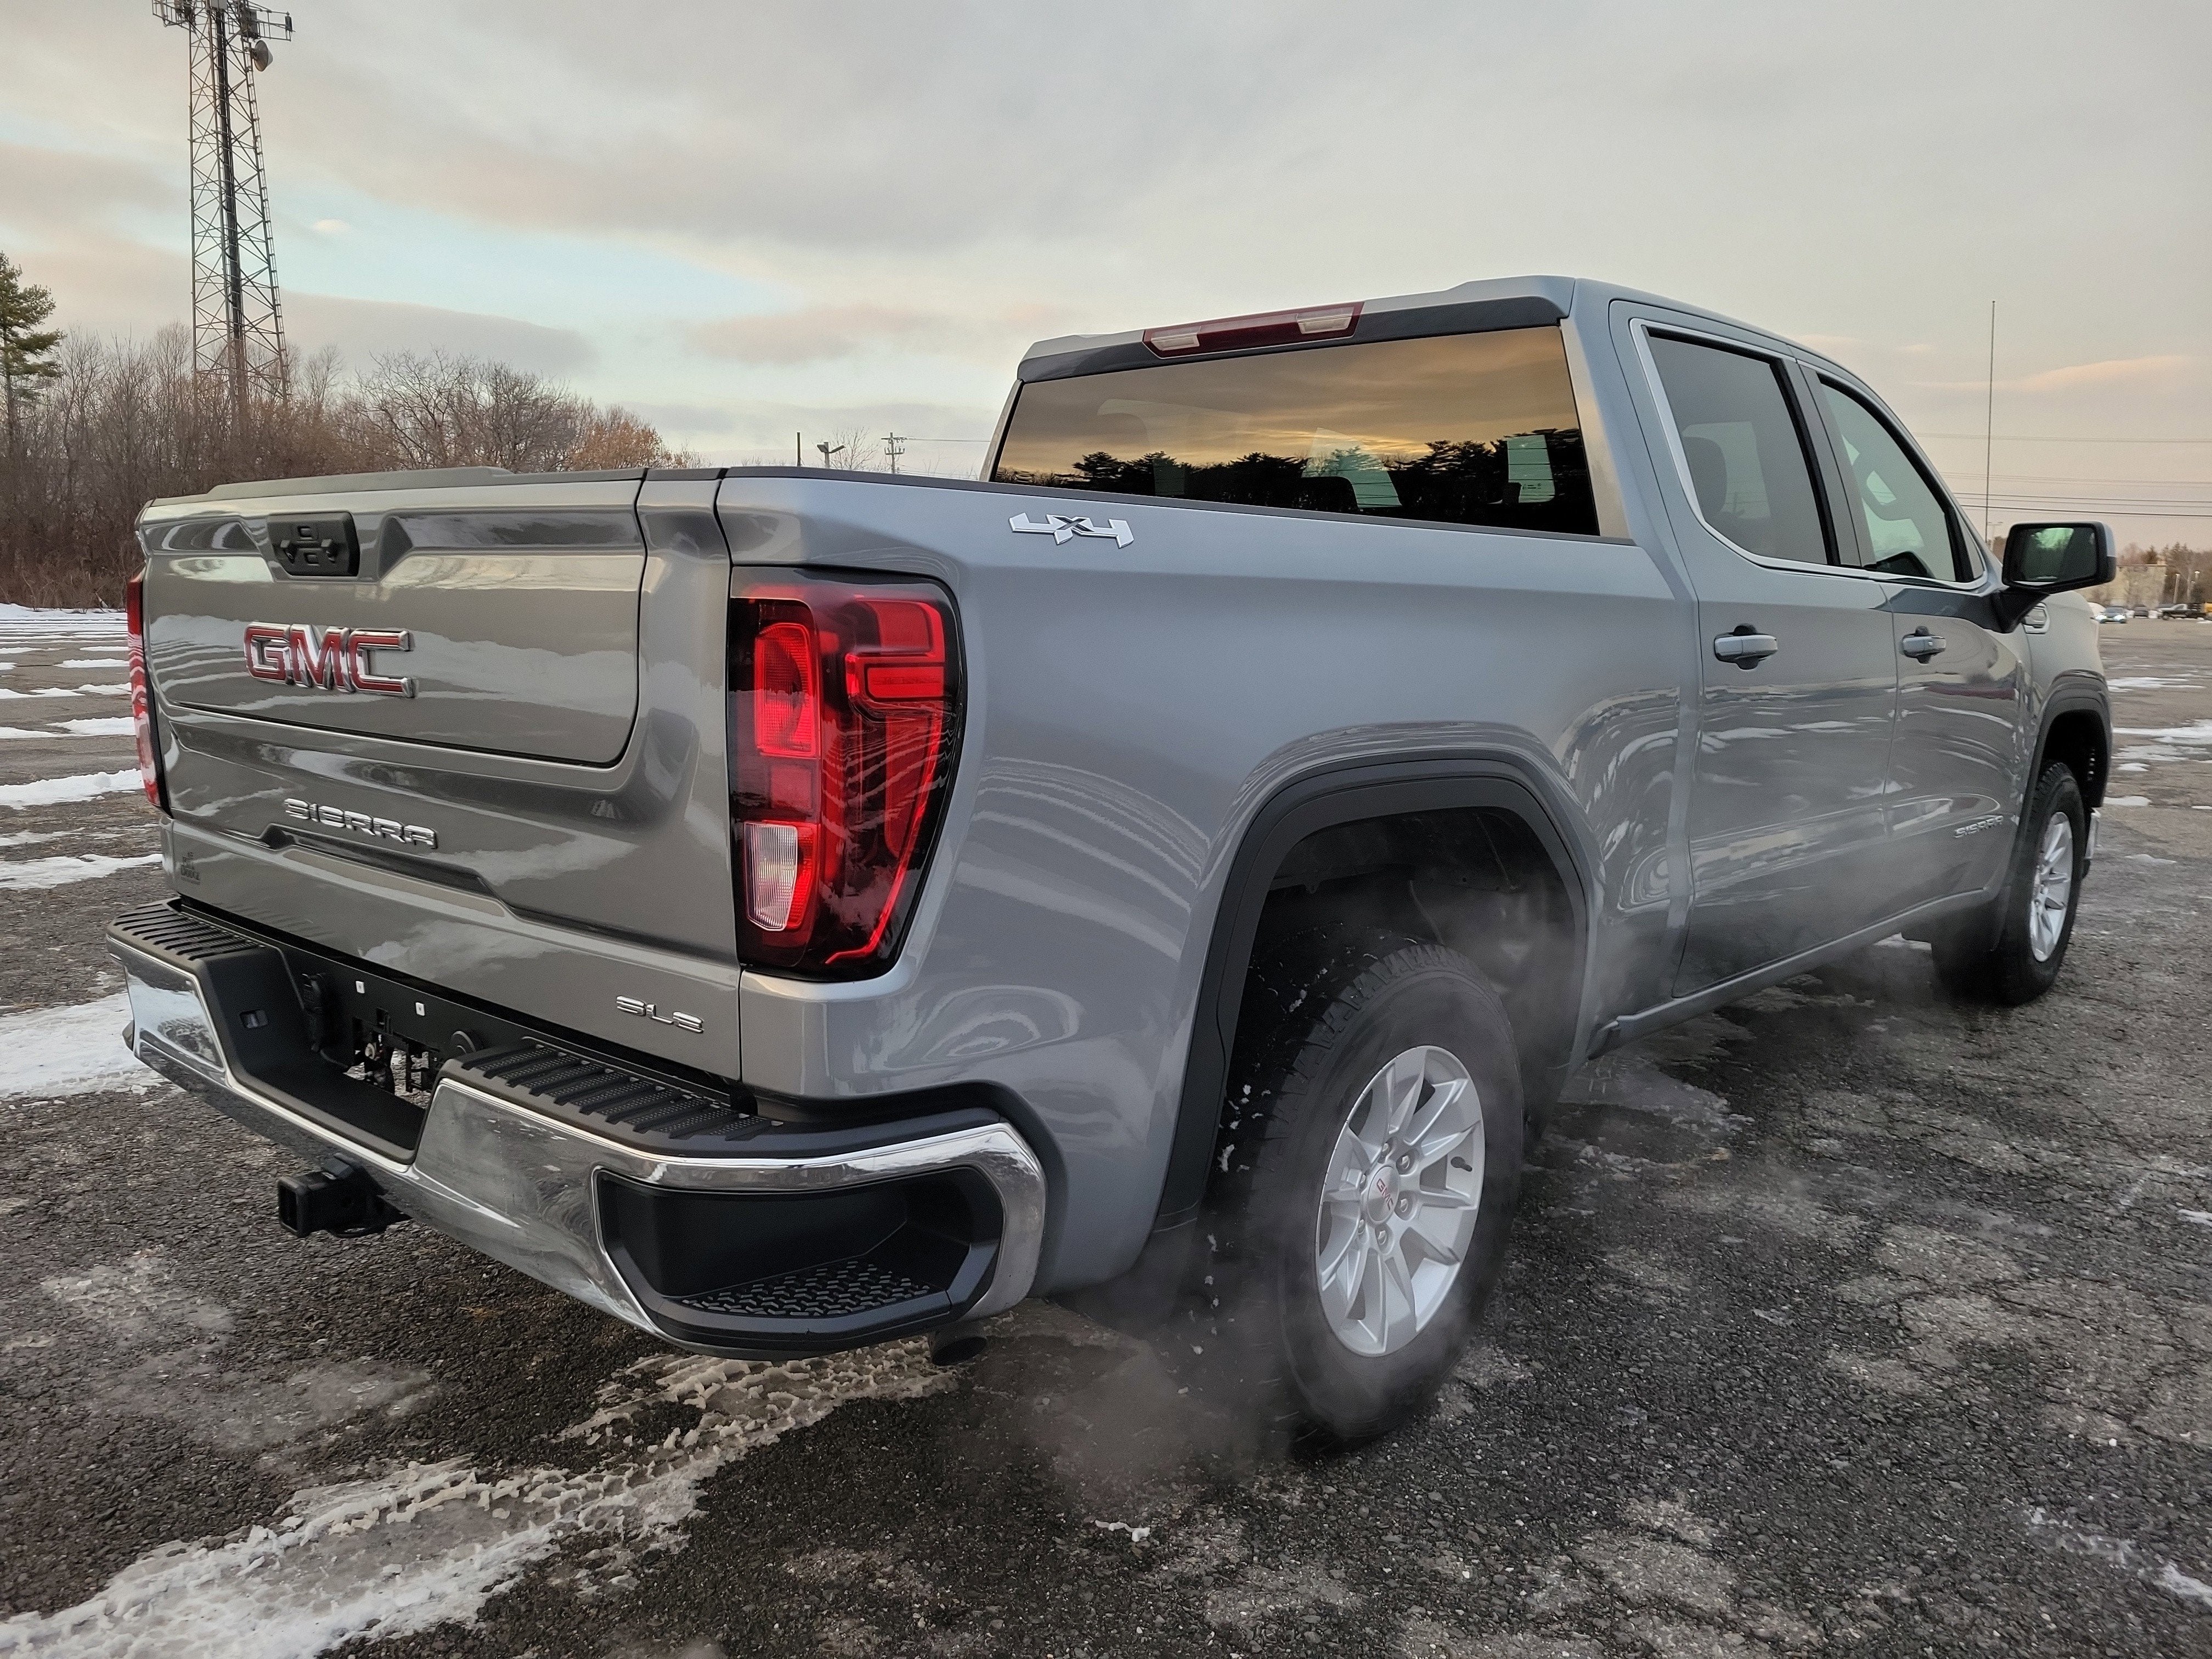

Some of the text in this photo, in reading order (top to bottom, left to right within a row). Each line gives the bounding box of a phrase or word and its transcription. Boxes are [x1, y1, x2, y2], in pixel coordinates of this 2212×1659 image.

[244, 621, 419, 698] GMC
[284, 797, 438, 849] SIERRA
[1954, 815, 2004, 838] SIERRA
[616, 995, 704, 1034] SLE
[1376, 1178, 1394, 1211] GMC
